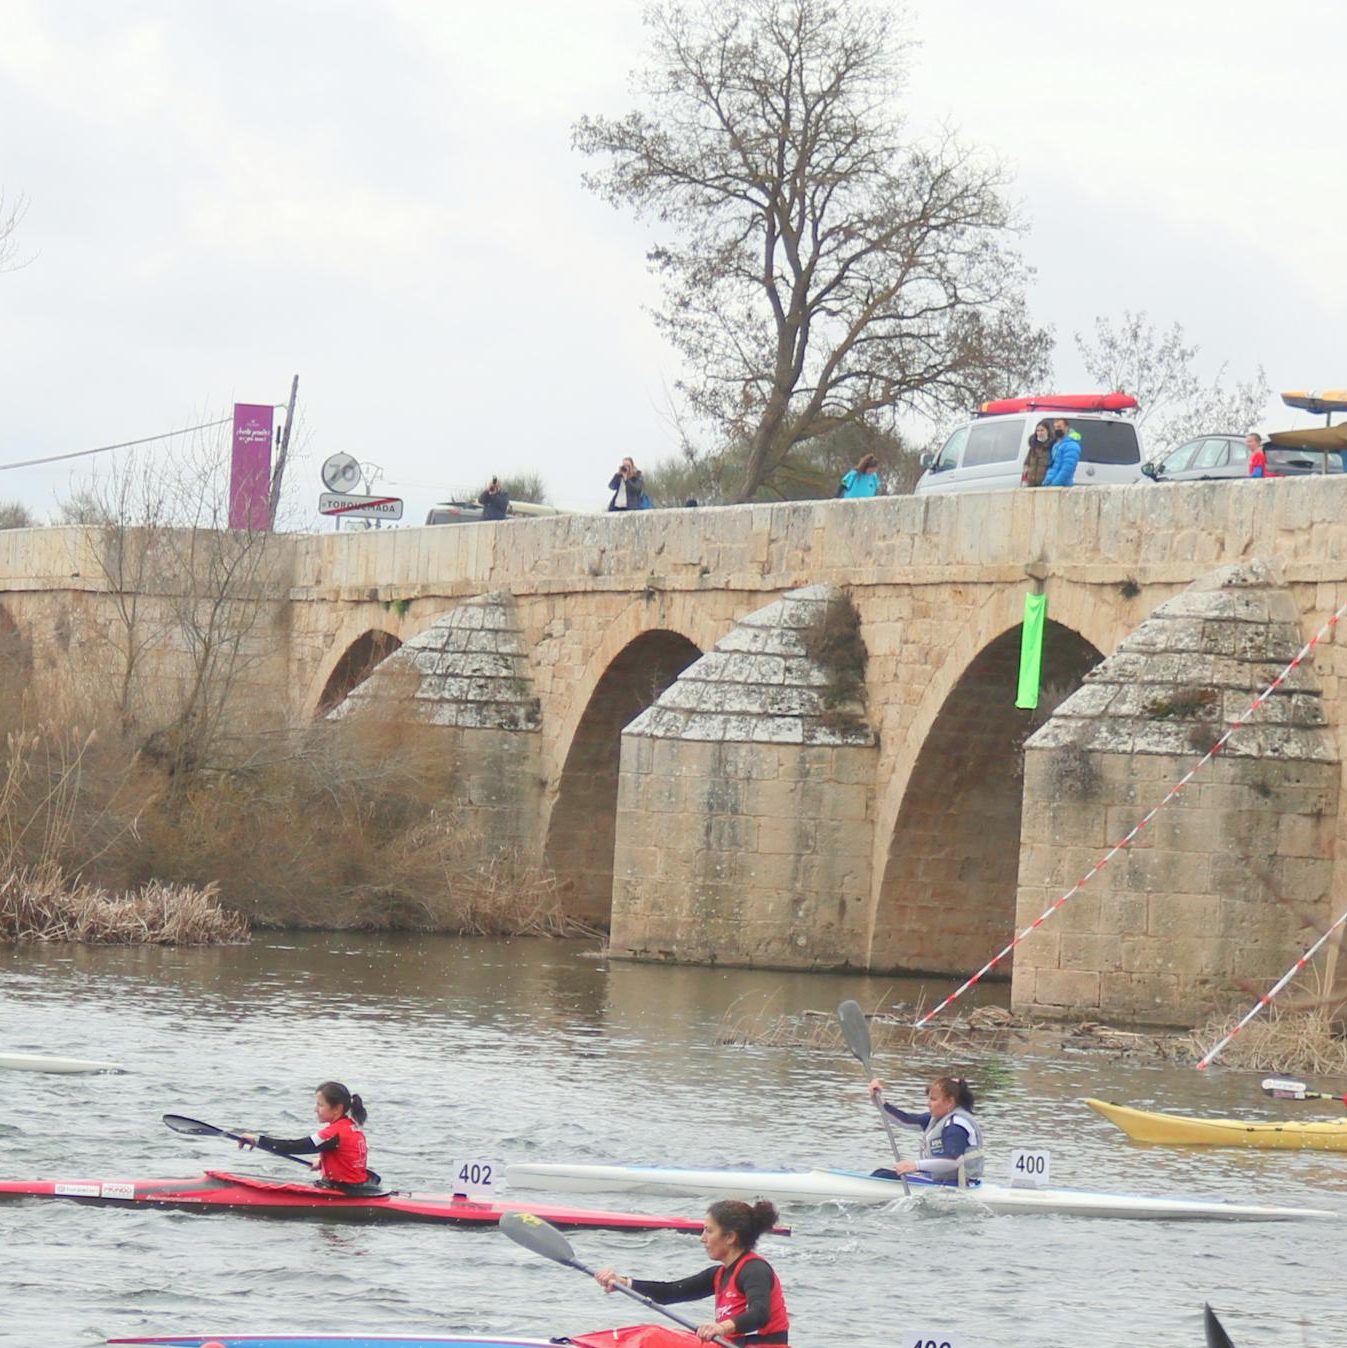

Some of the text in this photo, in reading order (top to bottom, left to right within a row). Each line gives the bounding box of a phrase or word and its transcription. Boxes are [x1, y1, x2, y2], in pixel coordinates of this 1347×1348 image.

[329, 463, 356, 482] 70
[458, 1163, 492, 1185] 402
[1015, 1154, 1045, 1174] 400
